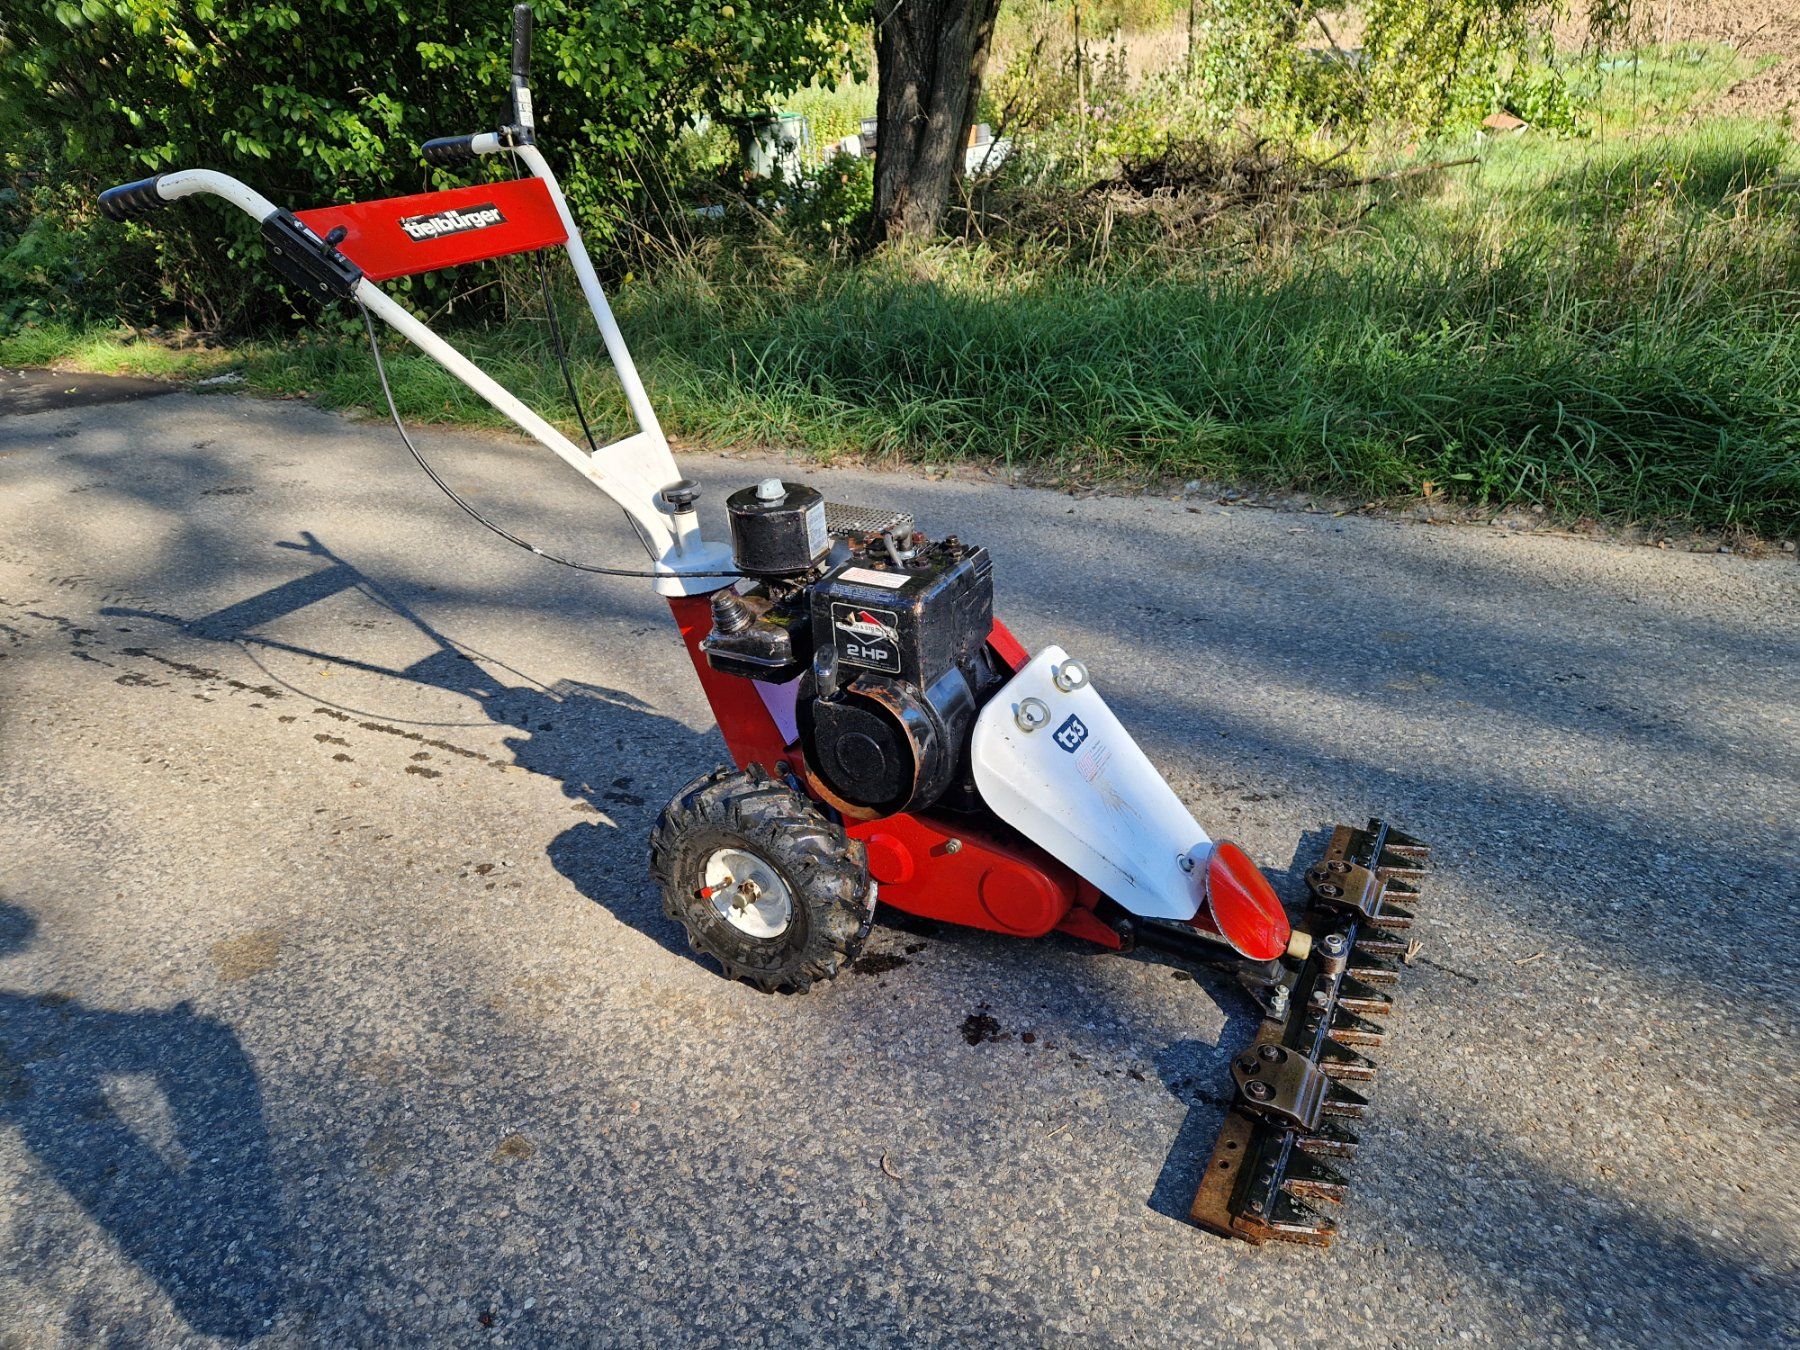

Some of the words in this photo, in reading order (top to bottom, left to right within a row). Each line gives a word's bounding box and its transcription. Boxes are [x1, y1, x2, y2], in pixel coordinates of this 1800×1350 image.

[403, 208, 501, 238] tielbürger
[846, 643, 860, 656] 2
[861, 646, 888, 660] HP
[1057, 719, 1085, 748] t33
